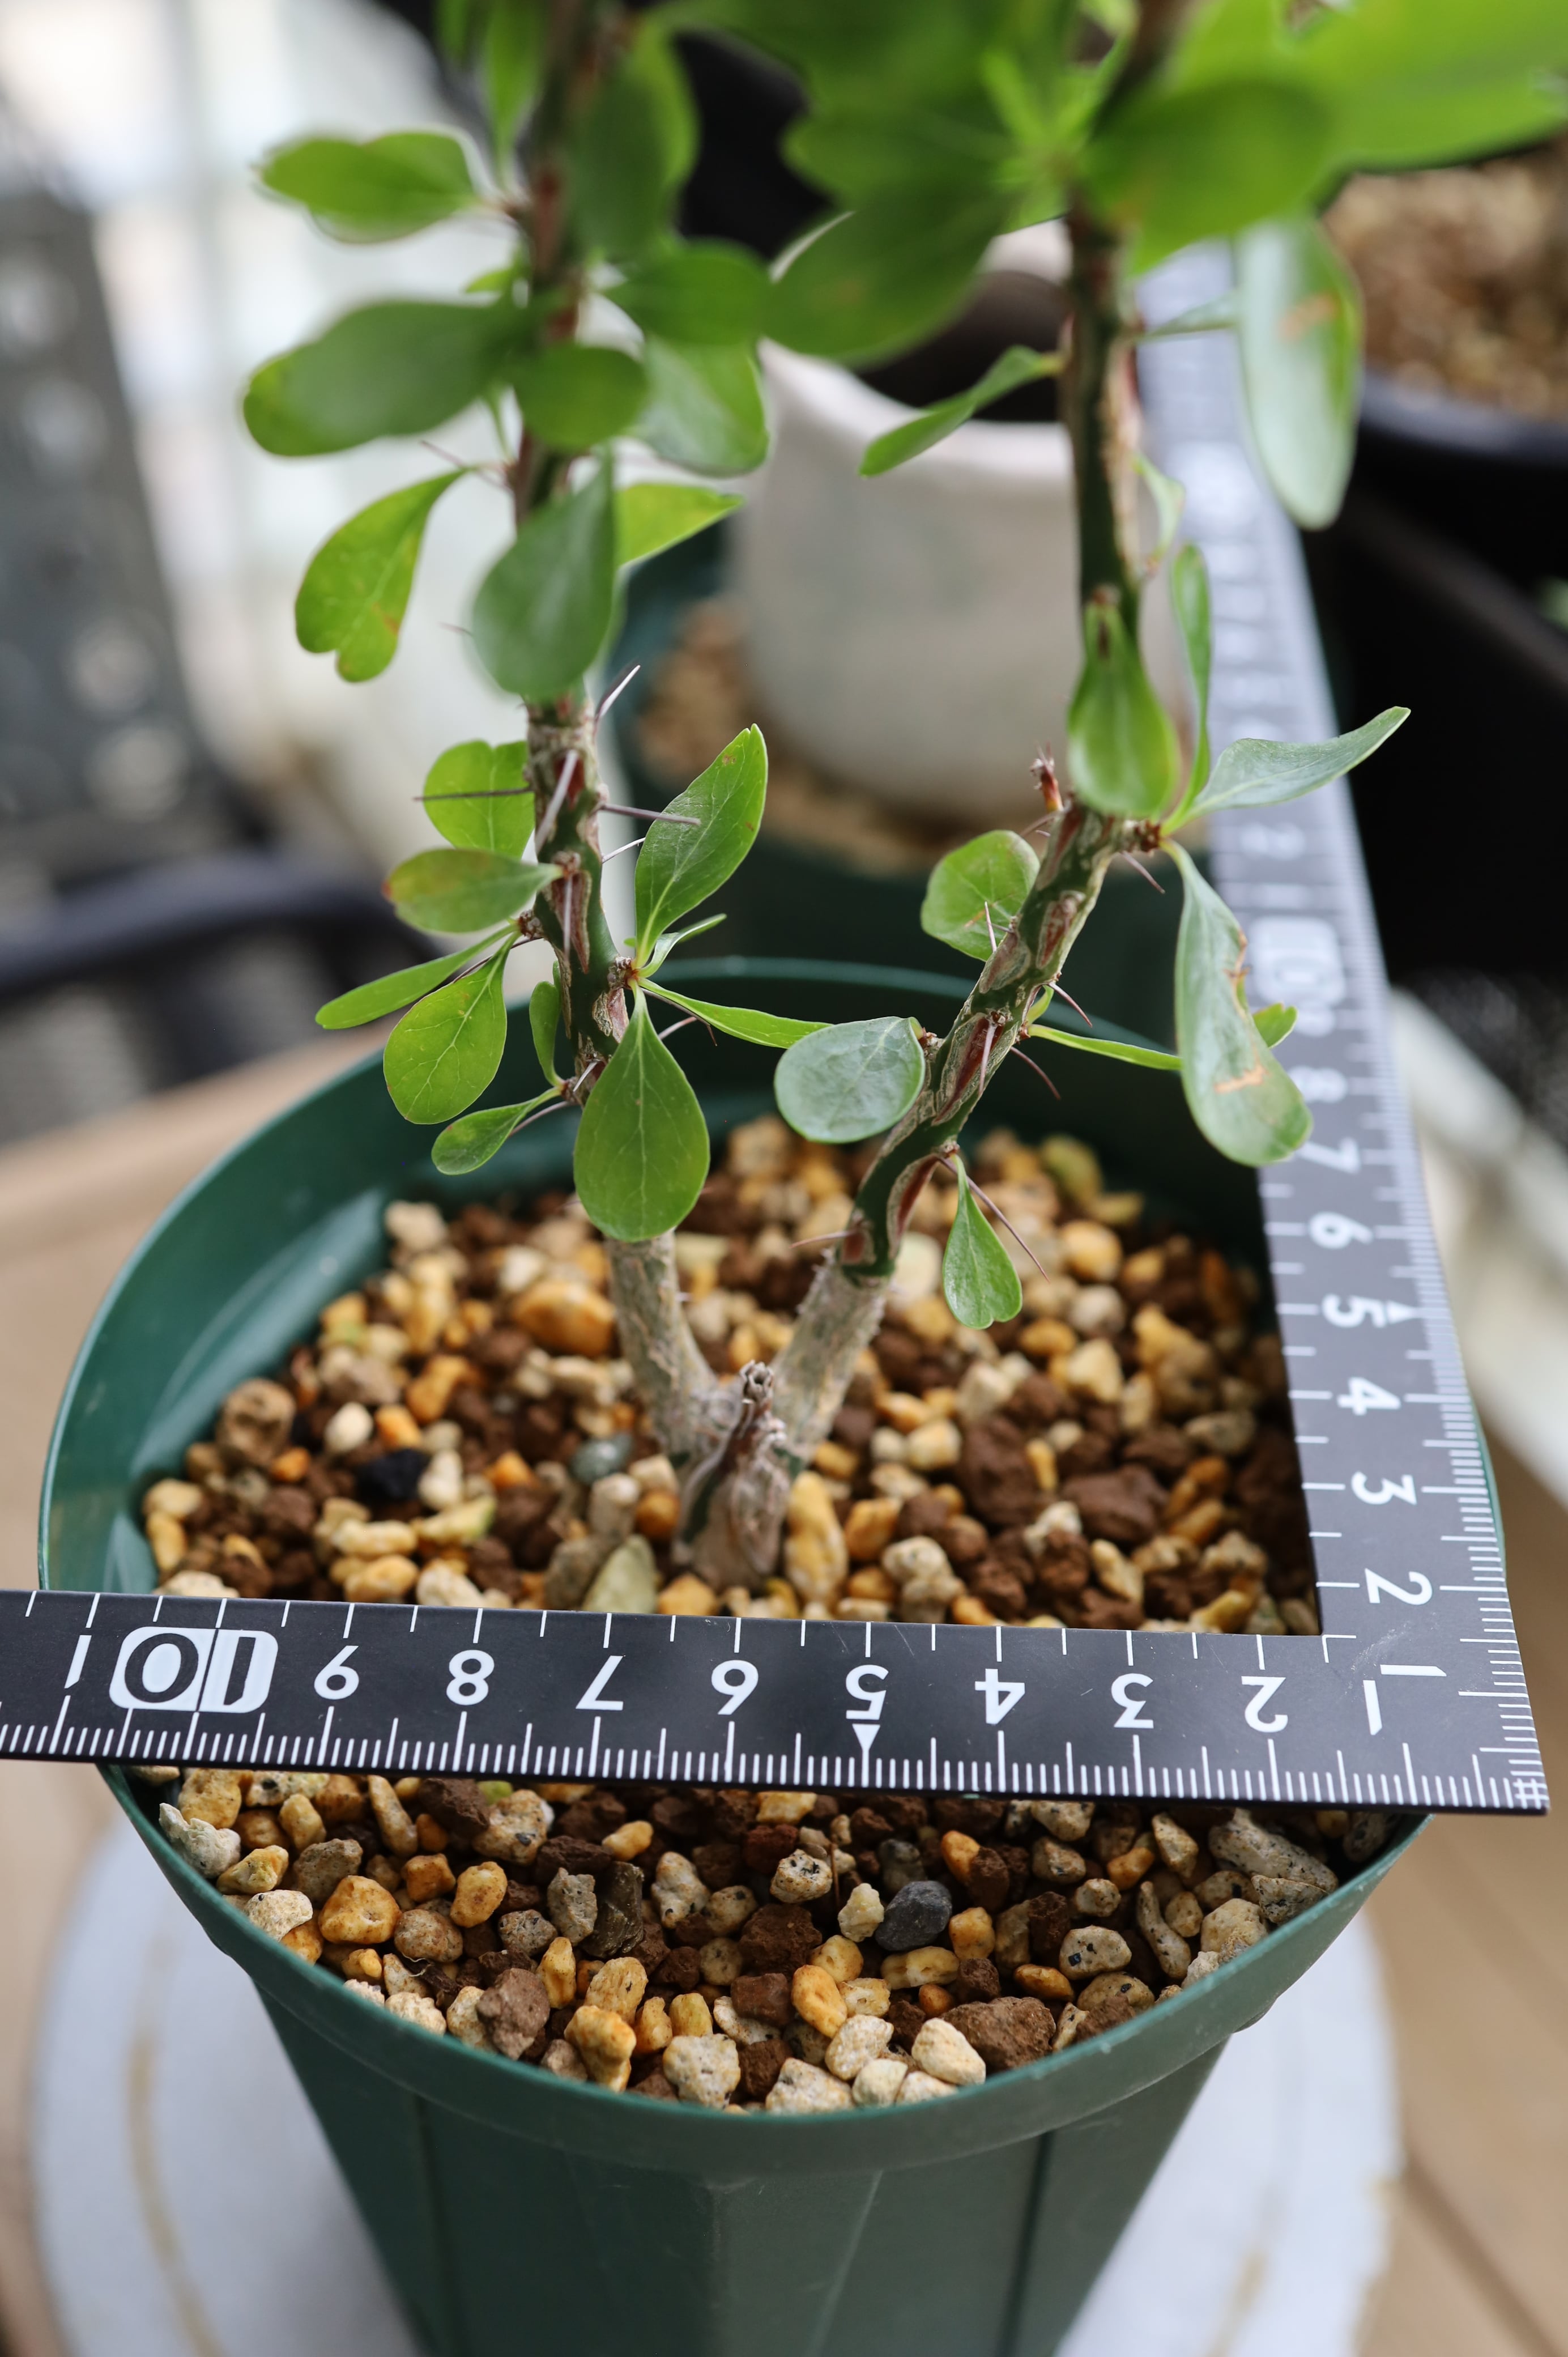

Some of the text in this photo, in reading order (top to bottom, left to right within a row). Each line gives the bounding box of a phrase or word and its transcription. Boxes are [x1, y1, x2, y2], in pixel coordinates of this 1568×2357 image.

[1296, 1137, 1361, 1173] 7
[1308, 1212, 1373, 1249] 6
[1322, 1294, 1387, 1328] 5
[1336, 1377, 1401, 1415] 4
[1351, 1471, 1417, 1505] 3
[1364, 1568, 1433, 1606] 2
[63, 1632, 1383, 1736] 1 2 3 4 5 6 7 8 9 10 1
[1379, 1663, 1447, 1677] 1
